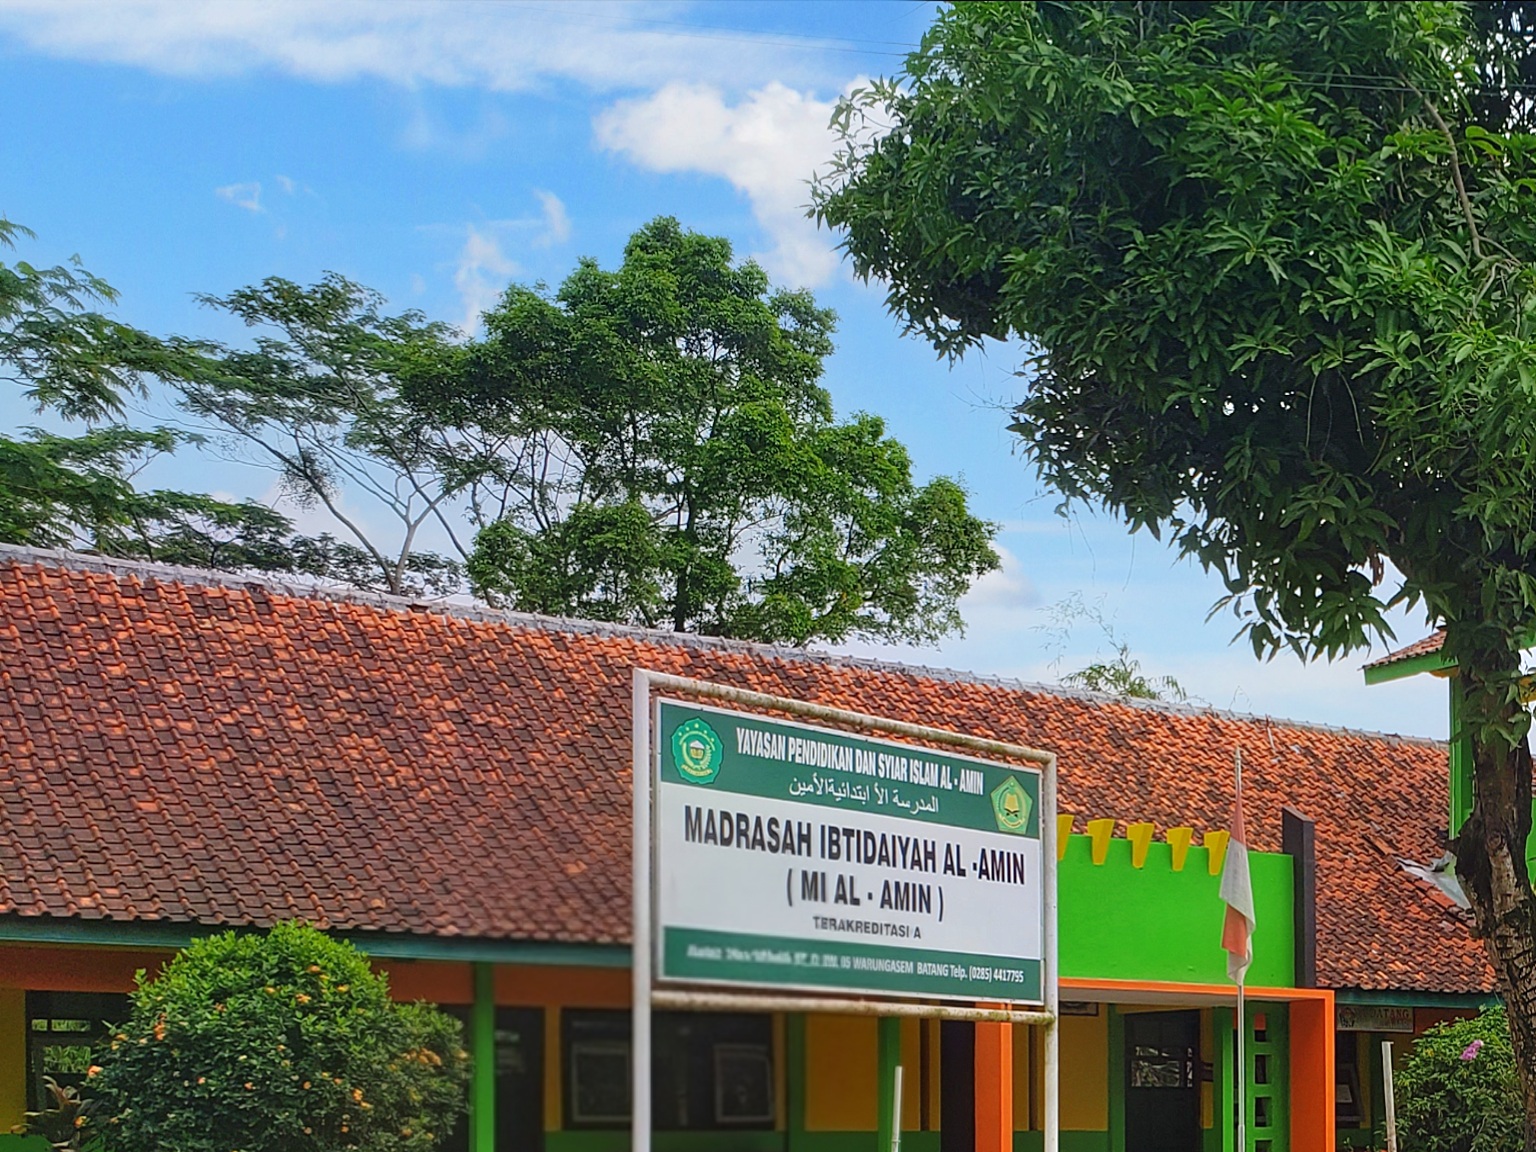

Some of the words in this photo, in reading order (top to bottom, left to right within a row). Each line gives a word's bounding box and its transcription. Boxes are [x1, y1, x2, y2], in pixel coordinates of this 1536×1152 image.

[736, 727, 786, 761] YAYASAN
[788, 737, 853, 772] PENDIDIKAN
[855, 748, 877, 775] DAN
[878, 753, 908, 781] SYIAR
[909, 759, 939, 786] ISLAM
[940, 765, 952, 790] AL
[959, 769, 984, 795] AMIN
[892, 789, 939, 815] المدرسة
[684, 805, 812, 858] MADRASAH
[819, 824, 936, 874] IBTIDAIYAH
[943, 843, 966, 877] AL
[801, 870, 826, 903] MI
[834, 874, 860, 906] AL
[880, 879, 932, 915] AMIN
[812, 915, 910, 938] TERAKREDITASI
[913, 926, 922, 940] A
[852, 956, 914, 974] WARUNGASEM
[917, 962, 949, 977] BATANG
[949, 964, 968, 981] Telp.
[969, 965, 992, 983] (0285)
[993, 968, 1024, 983] 4417795
